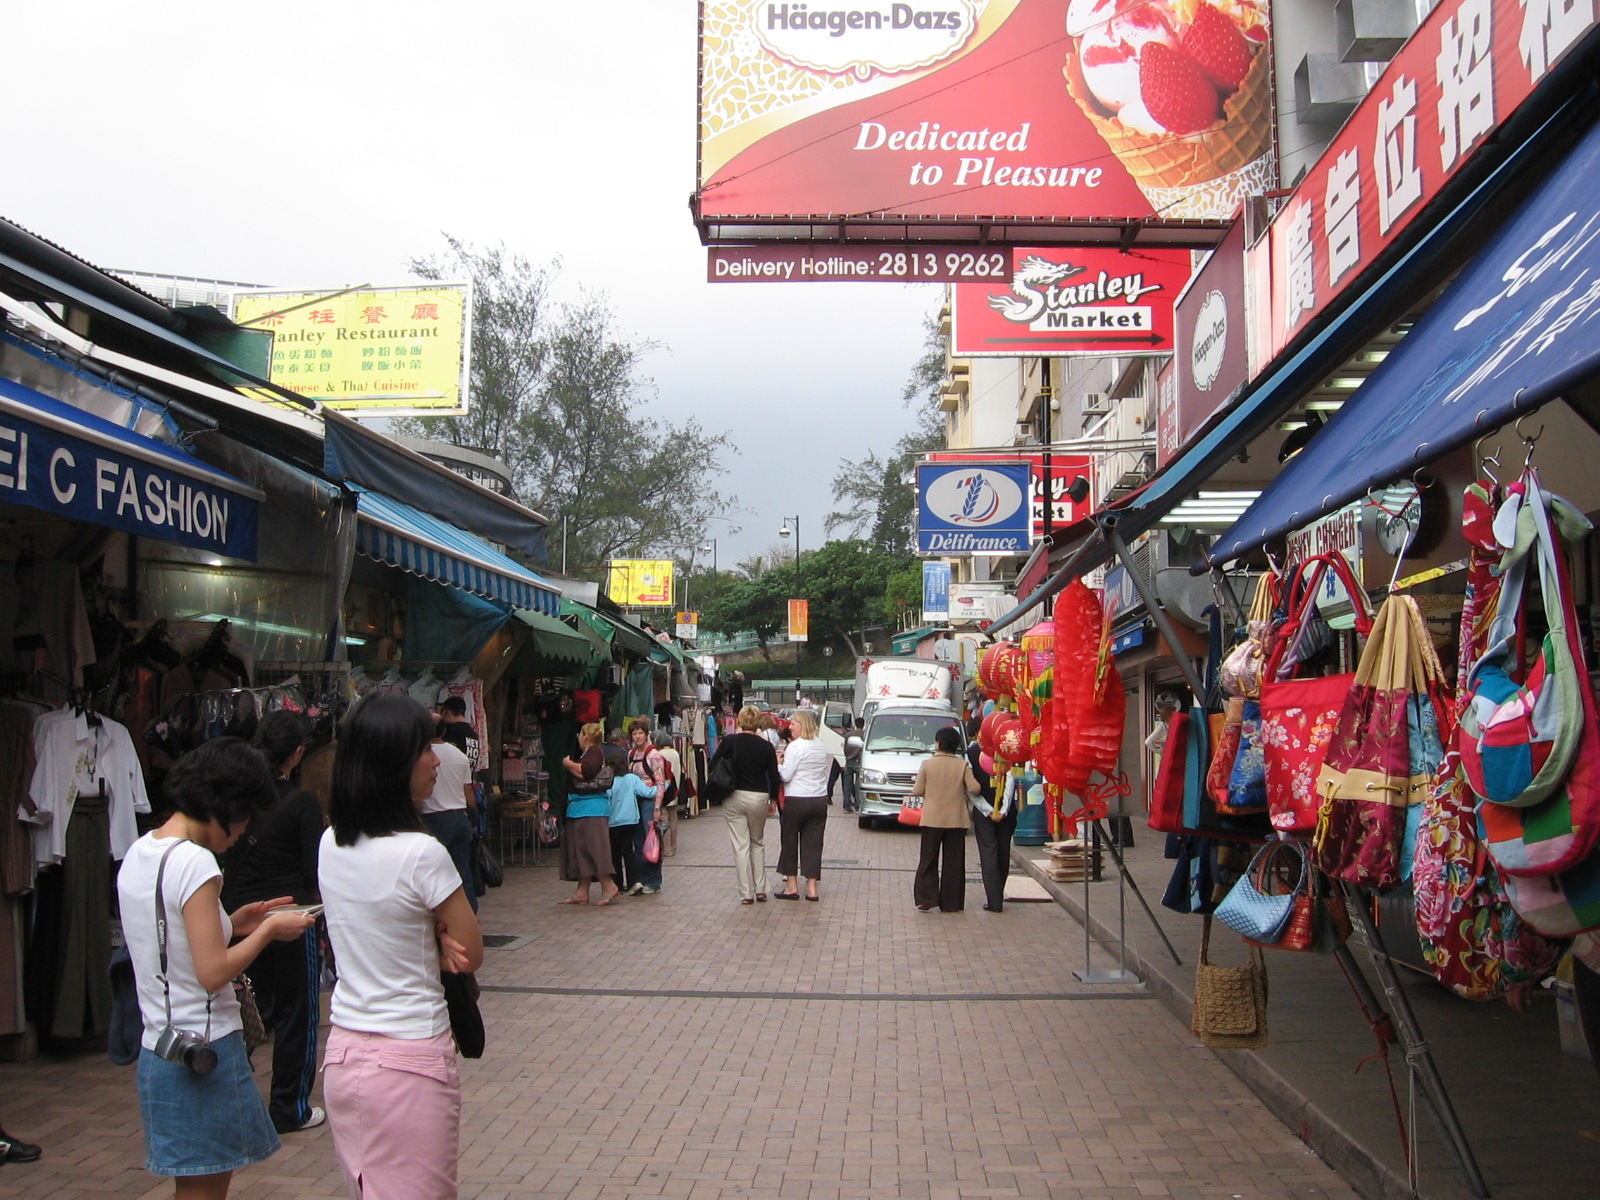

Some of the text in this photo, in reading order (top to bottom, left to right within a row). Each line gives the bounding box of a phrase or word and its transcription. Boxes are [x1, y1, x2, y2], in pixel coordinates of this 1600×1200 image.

[768, 3, 962, 37] Häagen-Dazs
[853, 121, 1031, 151] Dedicated
[909, 157, 1102, 187] to Pleasure
[715, 252, 1005, 279] Delivery Hotline: 2813 9262
[987, 255, 1161, 322] Stanley
[1047, 311, 1142, 328] Market
[273, 326, 439, 345] anley Restaurant
[1194, 317, 1225, 368] Häagen-Dazs
[325, 380, 335, 392] &
[374, 379, 418, 391] Cuisine
[50, 447, 77, 504] C
[96, 457, 228, 544] FASHION
[928, 533, 1018, 550] Délifrance
[466, 737, 478, 748] HEY
[467, 748, 478, 758] HO
